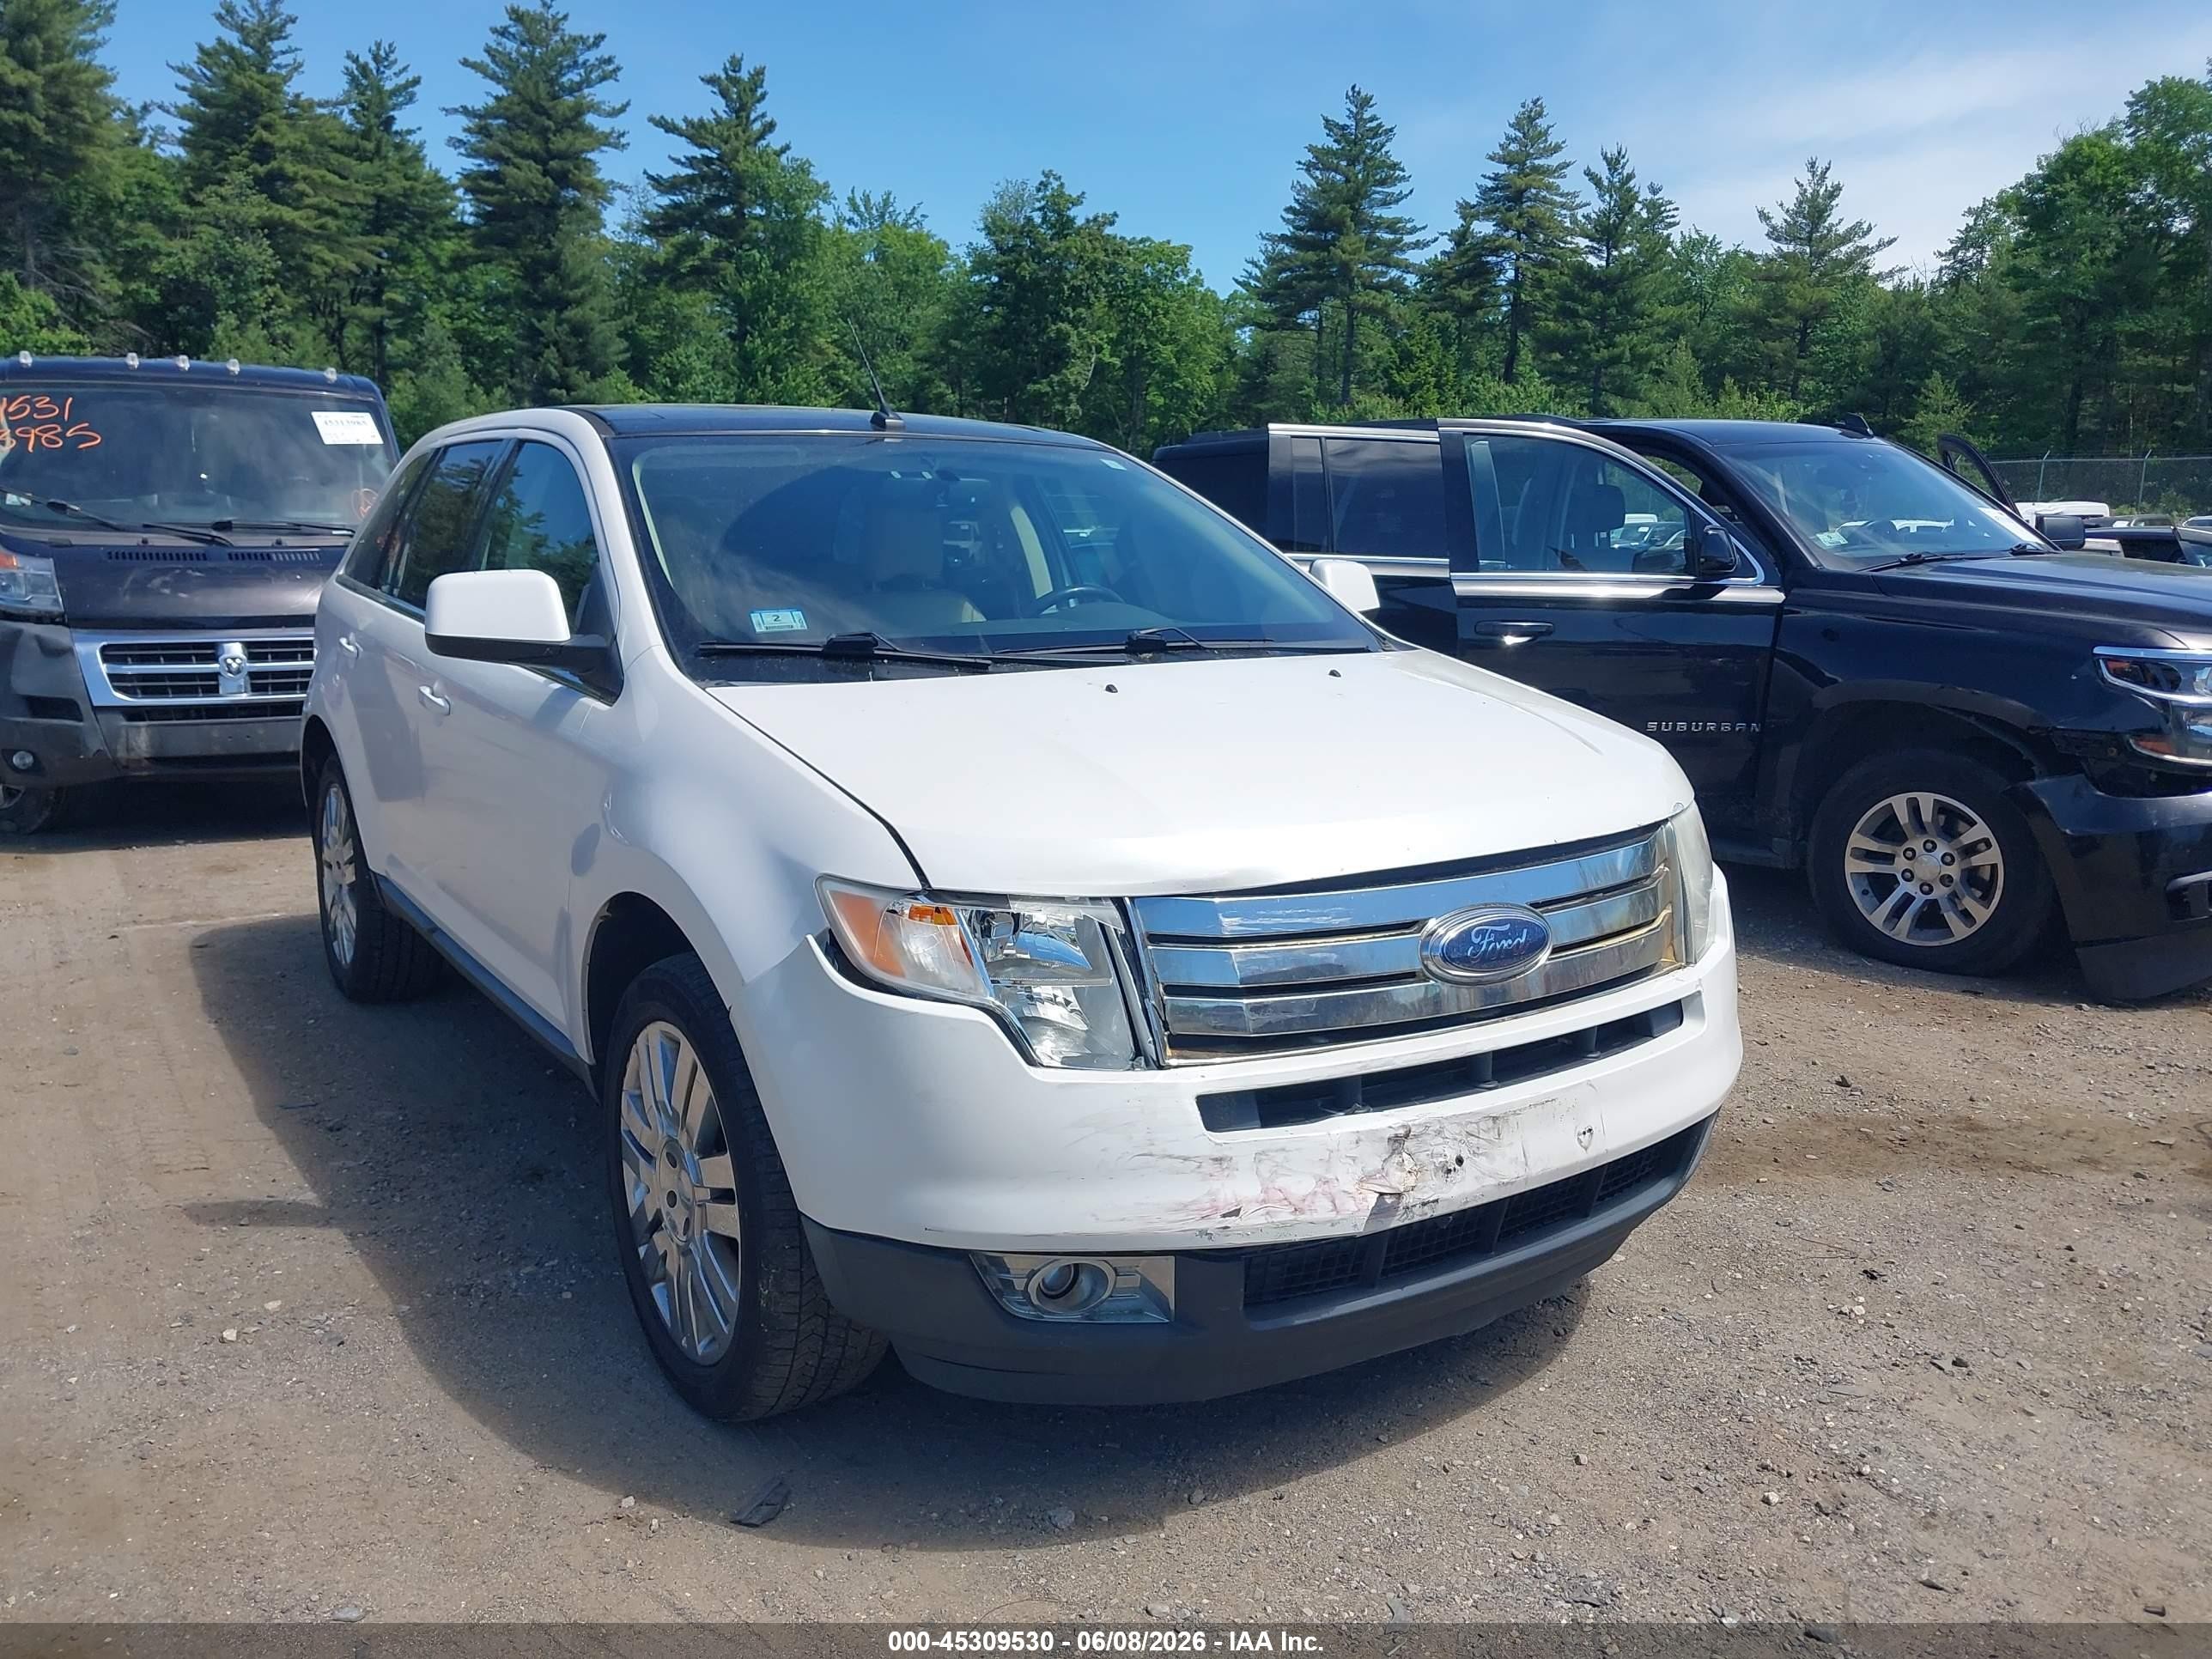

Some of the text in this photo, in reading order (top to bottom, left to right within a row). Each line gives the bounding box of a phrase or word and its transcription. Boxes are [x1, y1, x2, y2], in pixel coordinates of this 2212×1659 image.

[0, 395, 73, 422] 531
[1646, 721, 1761, 732] SUBURBAN
[1467, 923, 1527, 958] Ford
